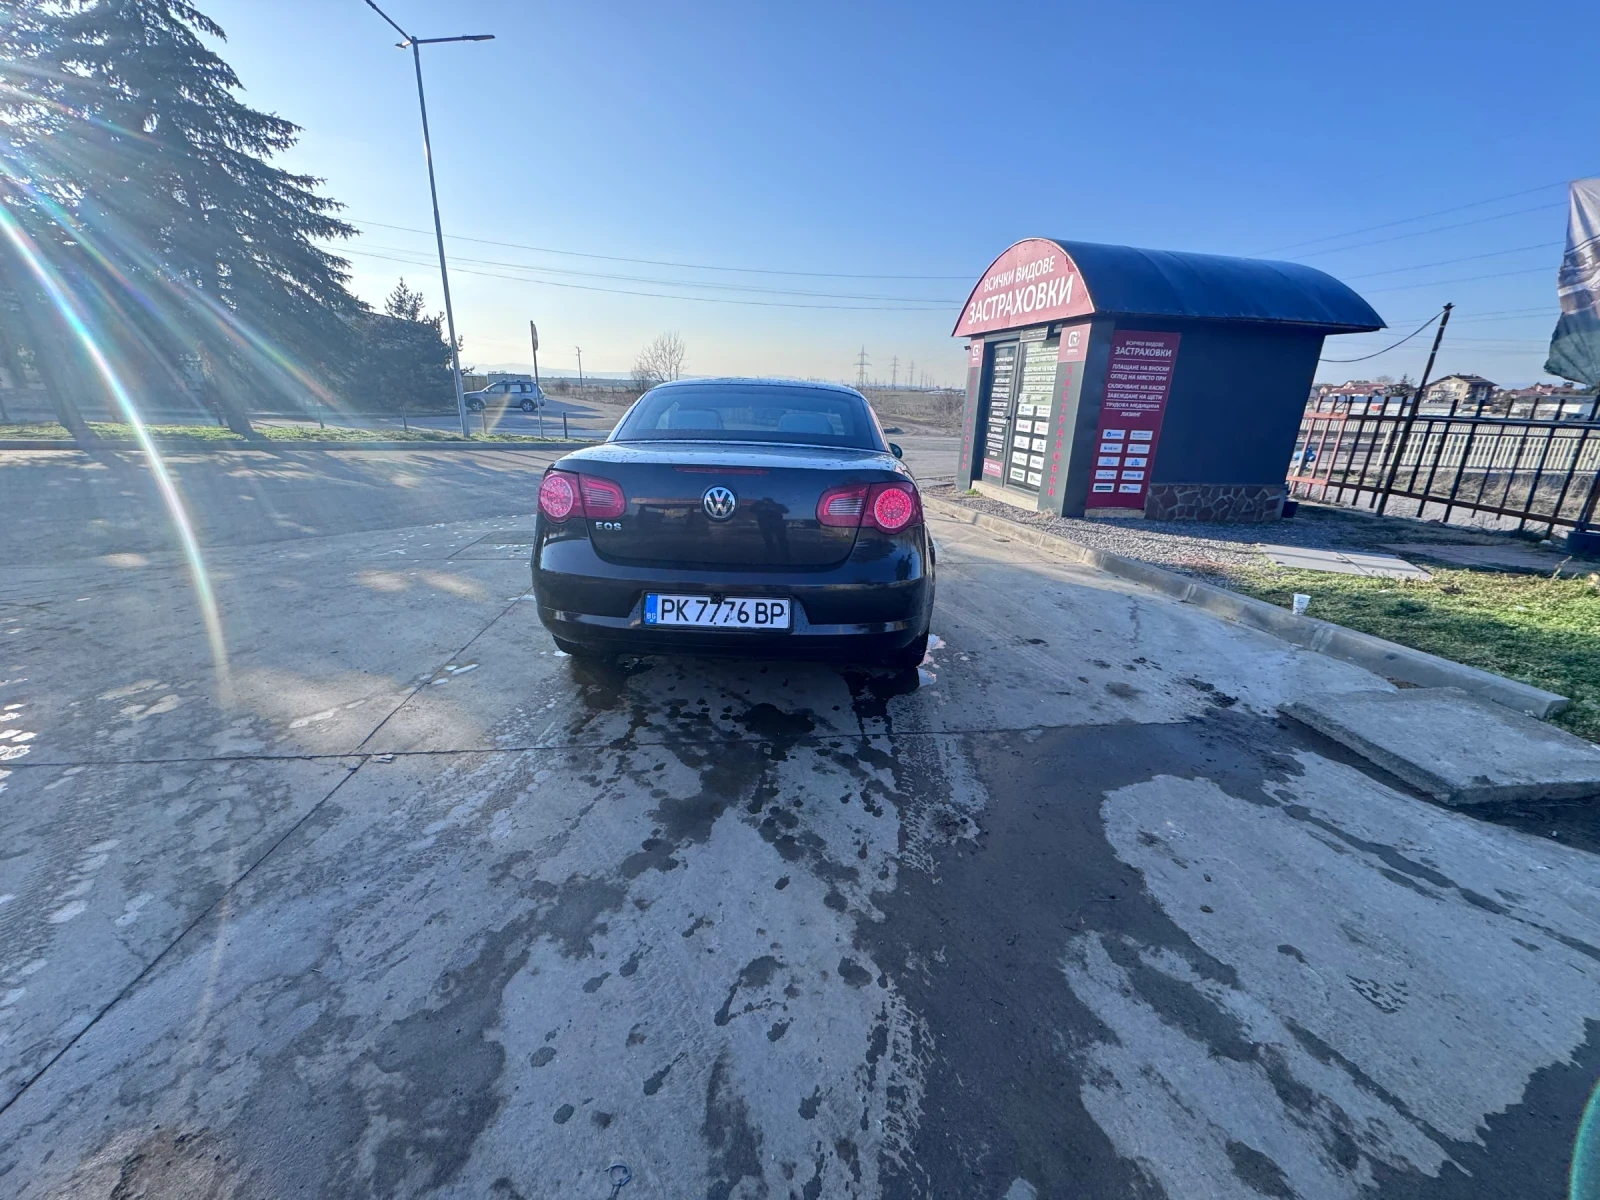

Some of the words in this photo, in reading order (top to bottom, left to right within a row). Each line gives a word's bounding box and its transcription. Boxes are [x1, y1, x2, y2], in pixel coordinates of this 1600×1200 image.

[984, 272, 1014, 292] ВСИЧКИ
[1015, 255, 1055, 283] ВИДОВЕ
[968, 274, 1074, 325] ЗАСТРАХОВКИ
[1114, 347, 1172, 357] ЗАСТРАХОВКИ
[595, 521, 622, 531] EOS
[647, 612, 656, 620] BG
[695, 600, 750, 624] 7776
